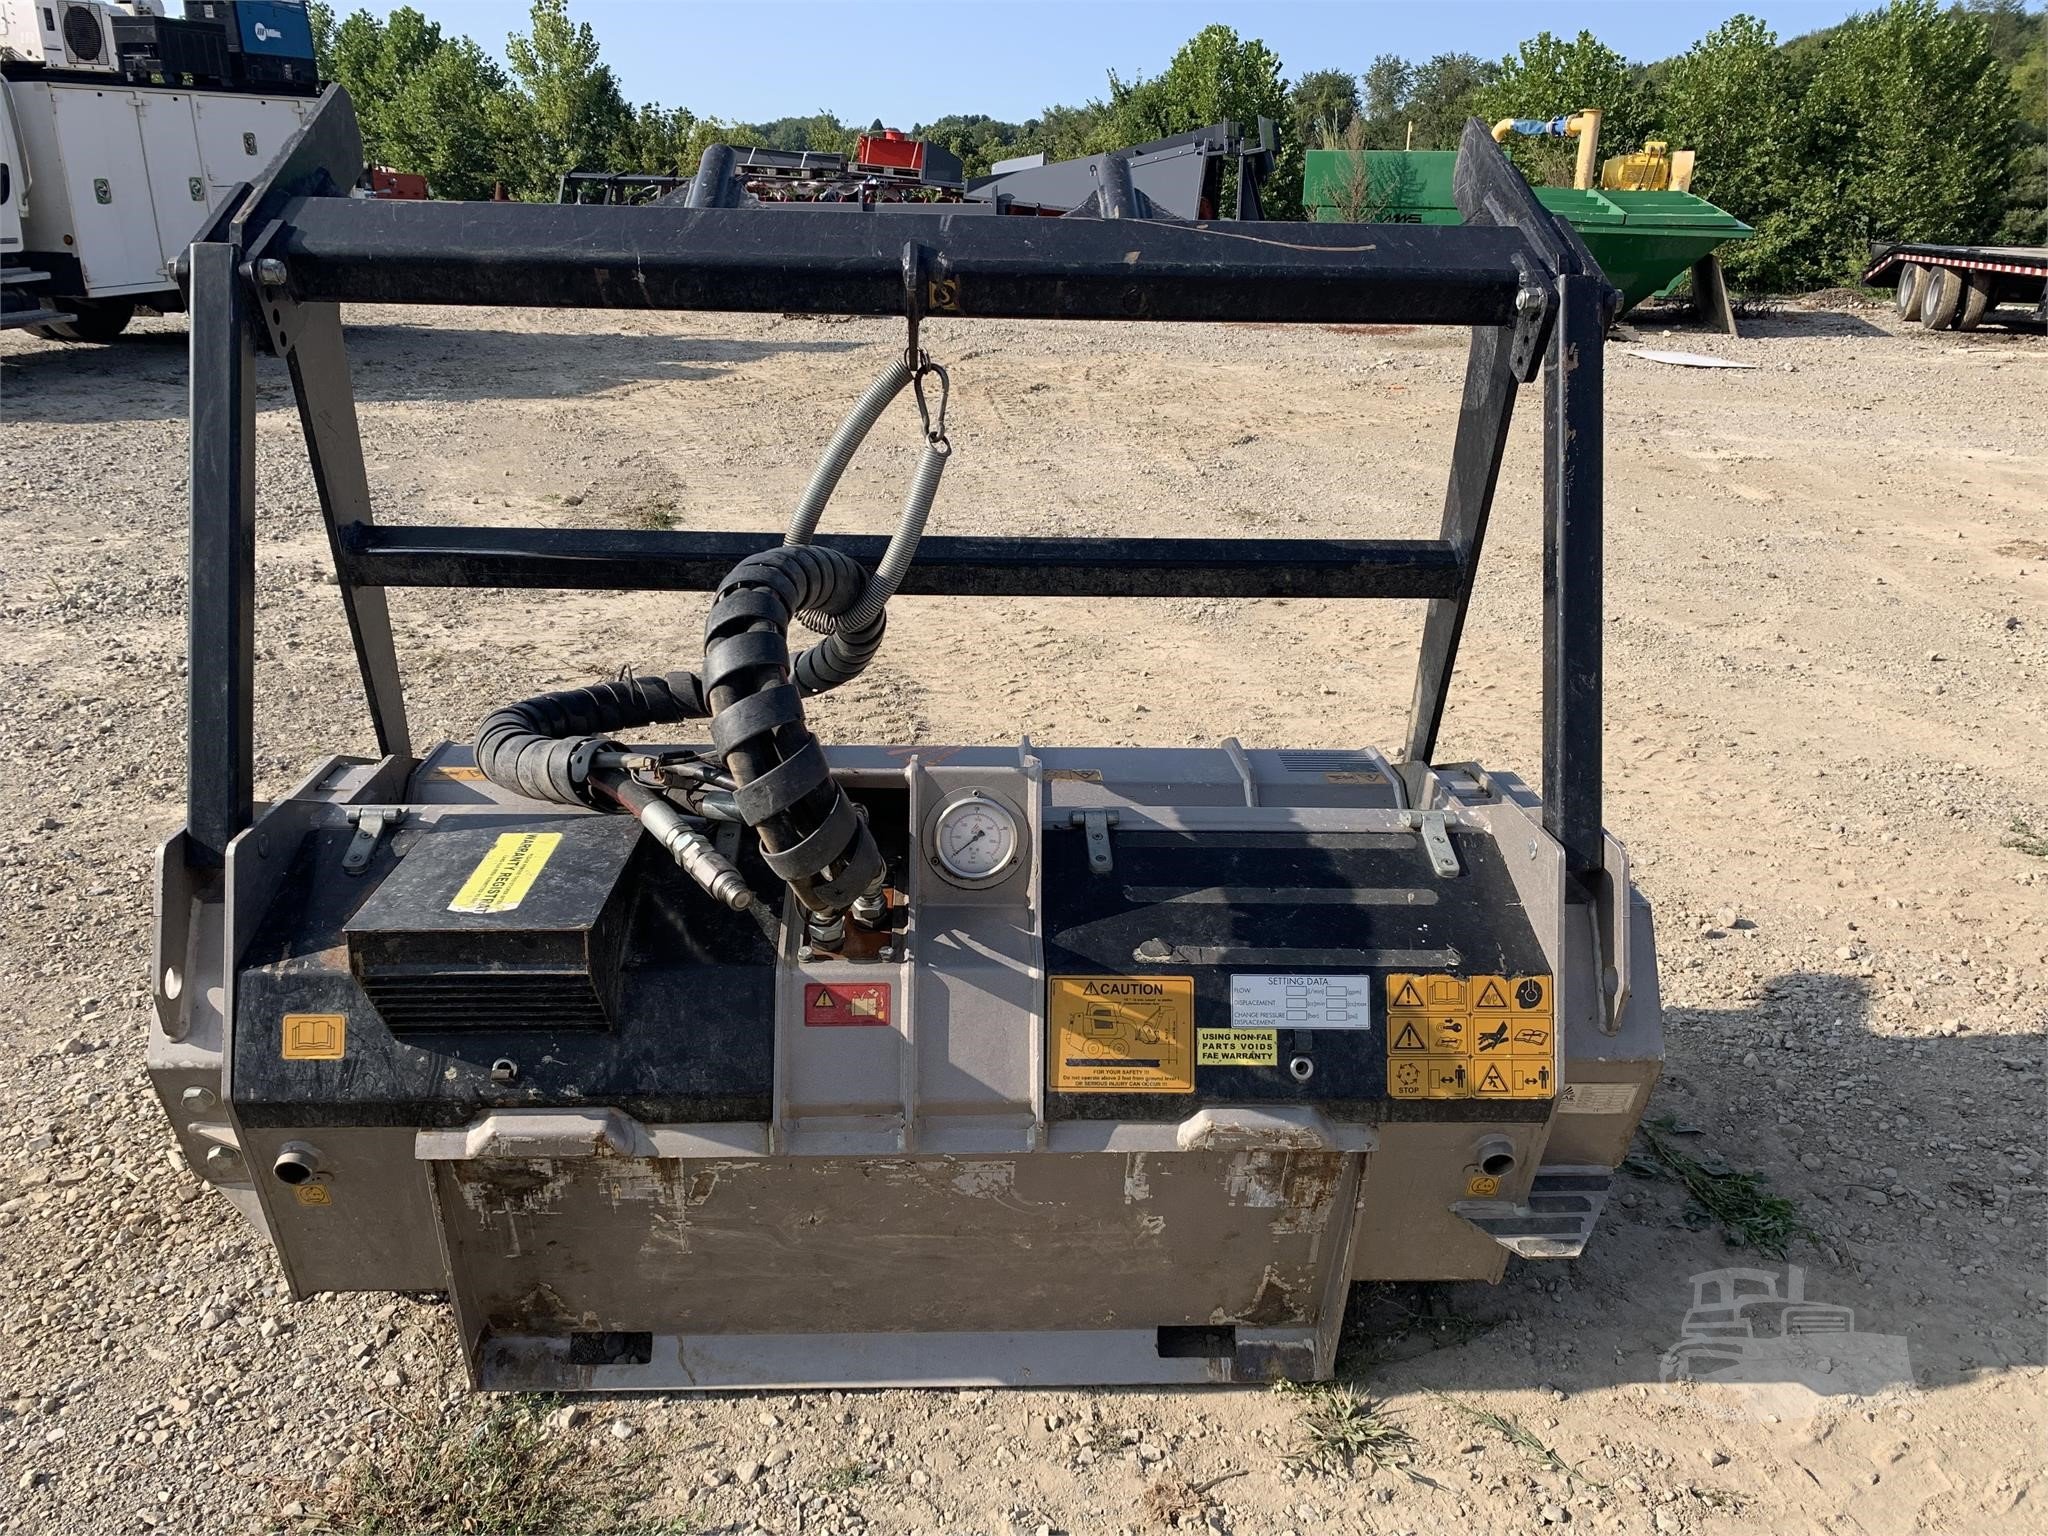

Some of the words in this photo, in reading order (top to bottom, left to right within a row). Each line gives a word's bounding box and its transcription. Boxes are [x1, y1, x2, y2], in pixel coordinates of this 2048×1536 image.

[503, 834, 538, 871] WARRANTY
[1268, 977, 1304, 985] SETTING
[1307, 977, 1329, 985] DATA
[1100, 983, 1163, 995] CAUTION
[1202, 1033, 1231, 1041] USING
[1233, 1033, 1273, 1041] NON-FAE
[1221, 1052, 1273, 1060] WARRANTY
